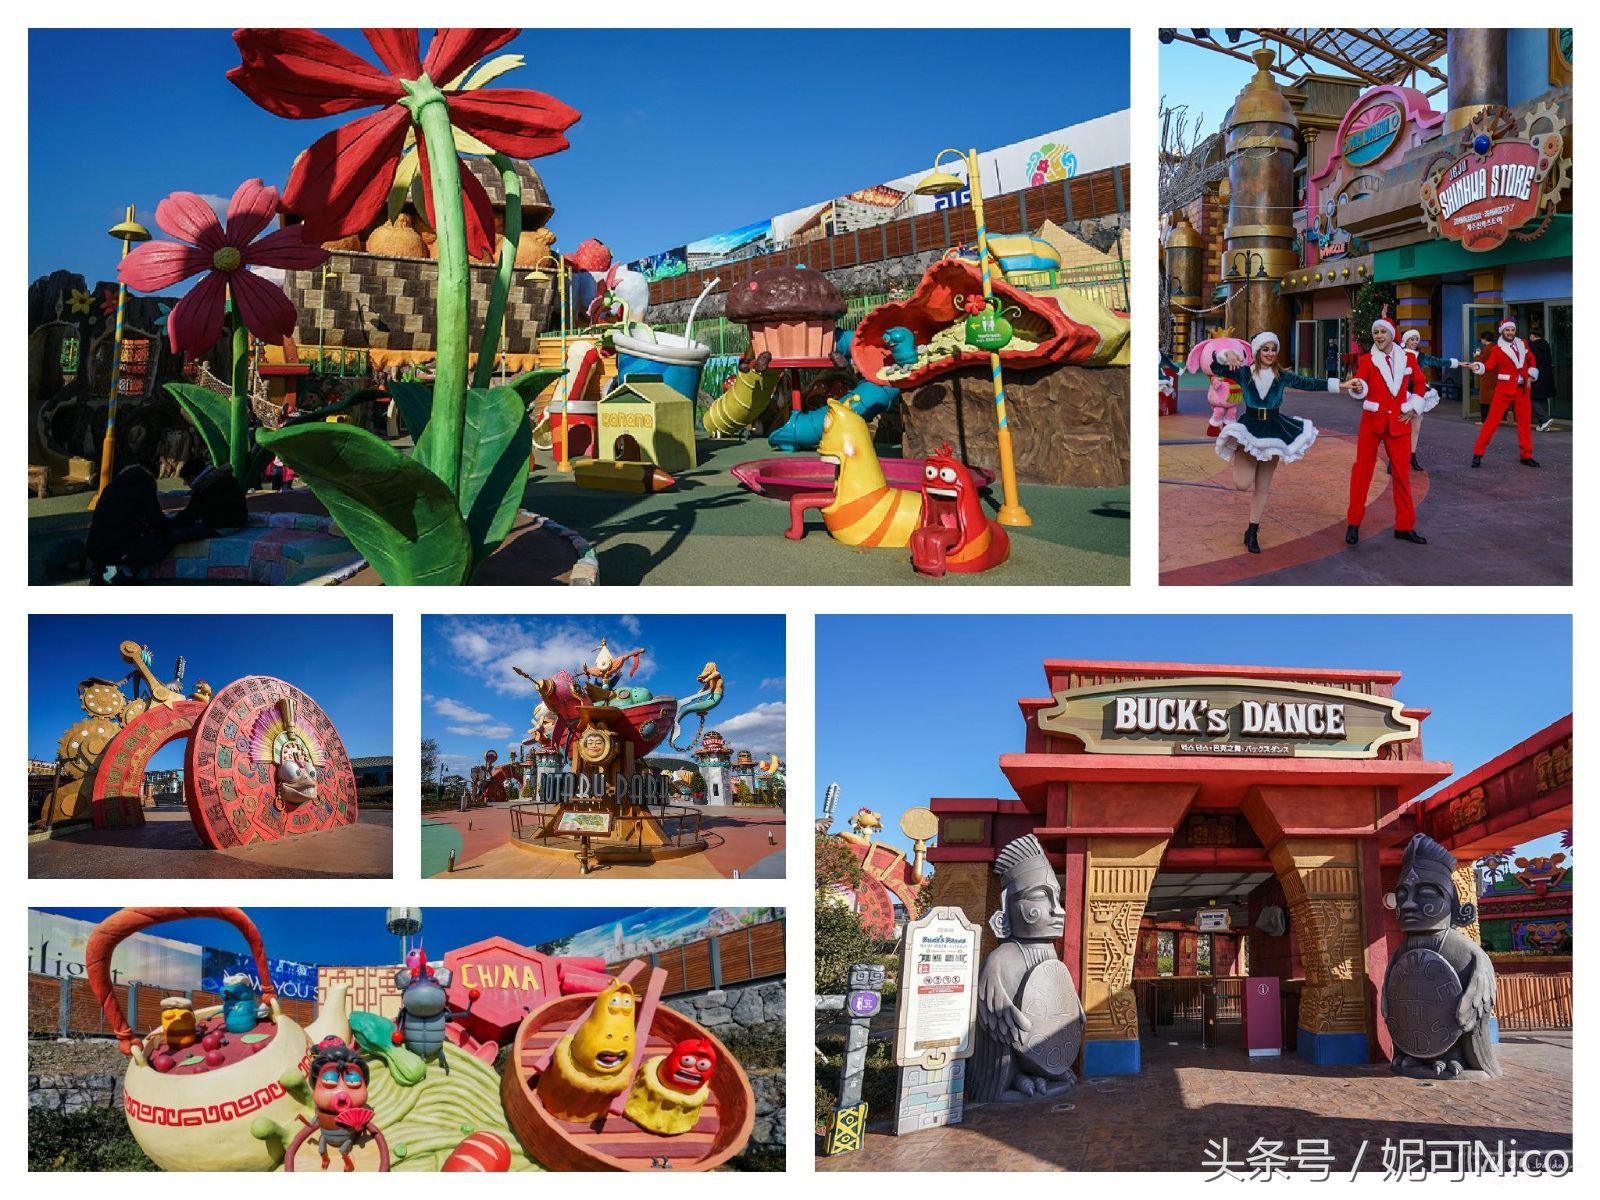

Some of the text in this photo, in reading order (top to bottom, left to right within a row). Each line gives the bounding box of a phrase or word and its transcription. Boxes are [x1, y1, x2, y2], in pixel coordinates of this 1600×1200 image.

[1439, 168, 1487, 220] SHINHWA
[1491, 163, 1536, 201] STORE
[1114, 696, 1346, 737] BUCK's DANCE
[616, 773, 671, 805] PARK
[460, 963, 540, 991] CHINA
